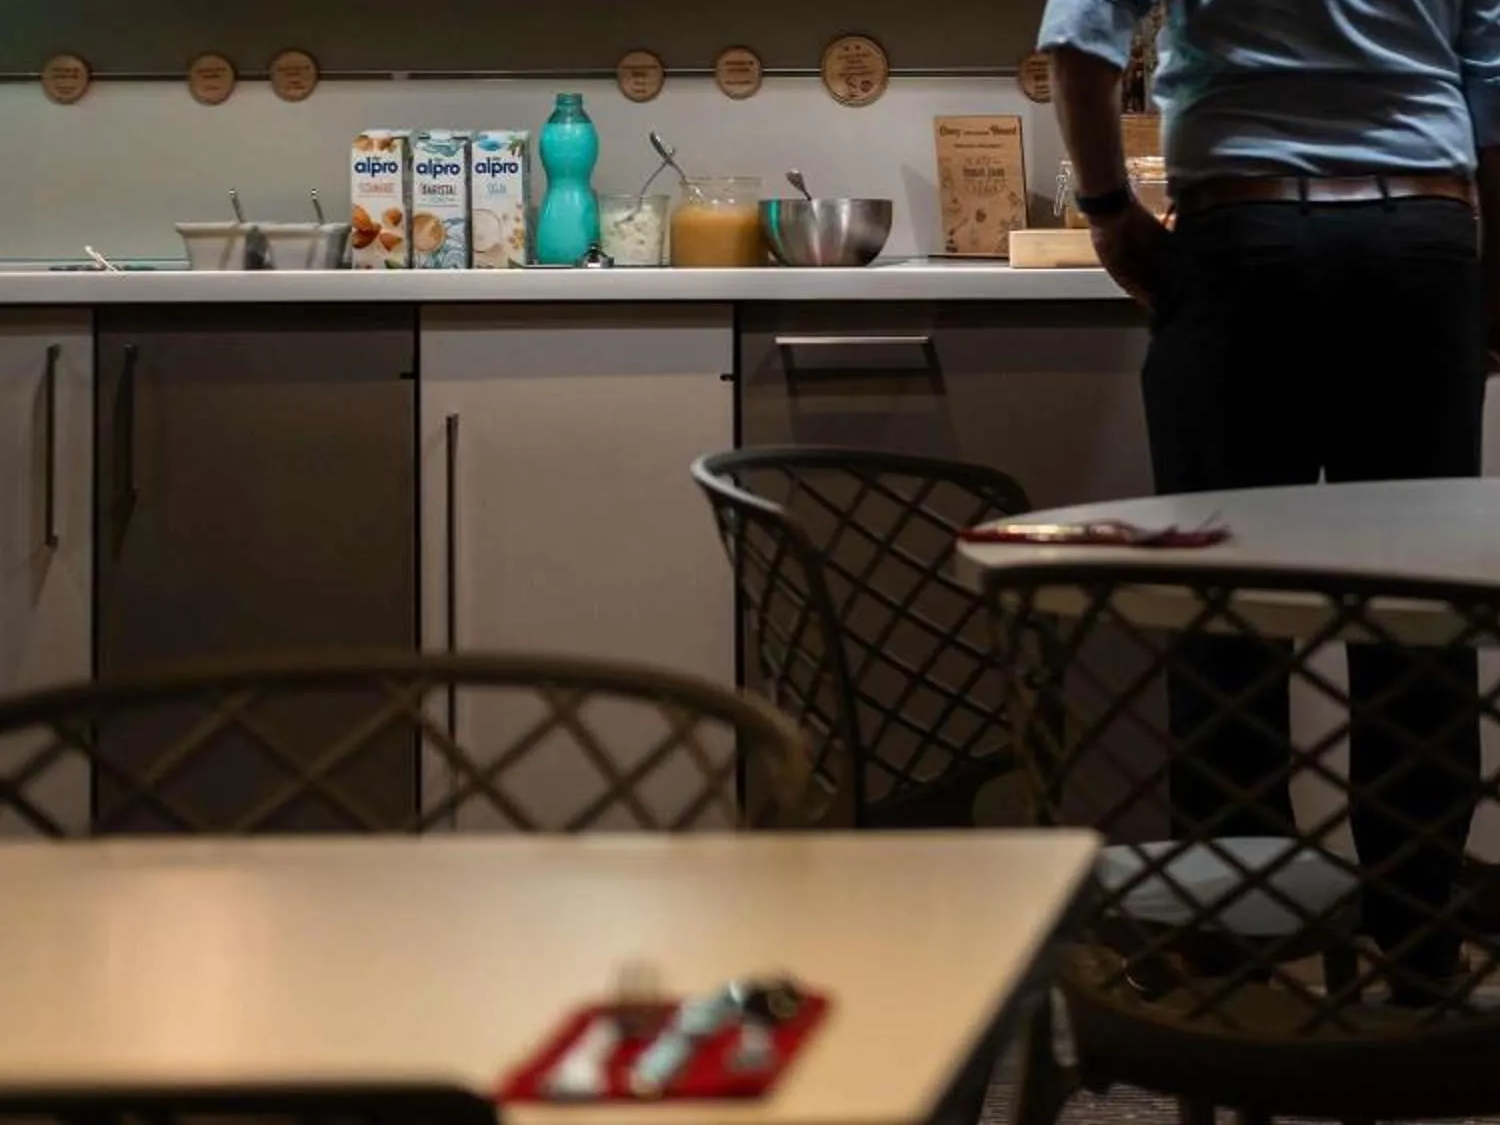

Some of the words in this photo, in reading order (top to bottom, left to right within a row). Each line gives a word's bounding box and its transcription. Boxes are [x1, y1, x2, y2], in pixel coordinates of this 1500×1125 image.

[354, 157, 398, 177] alpro
[416, 159, 460, 179] alpro
[475, 157, 518, 177] alpro
